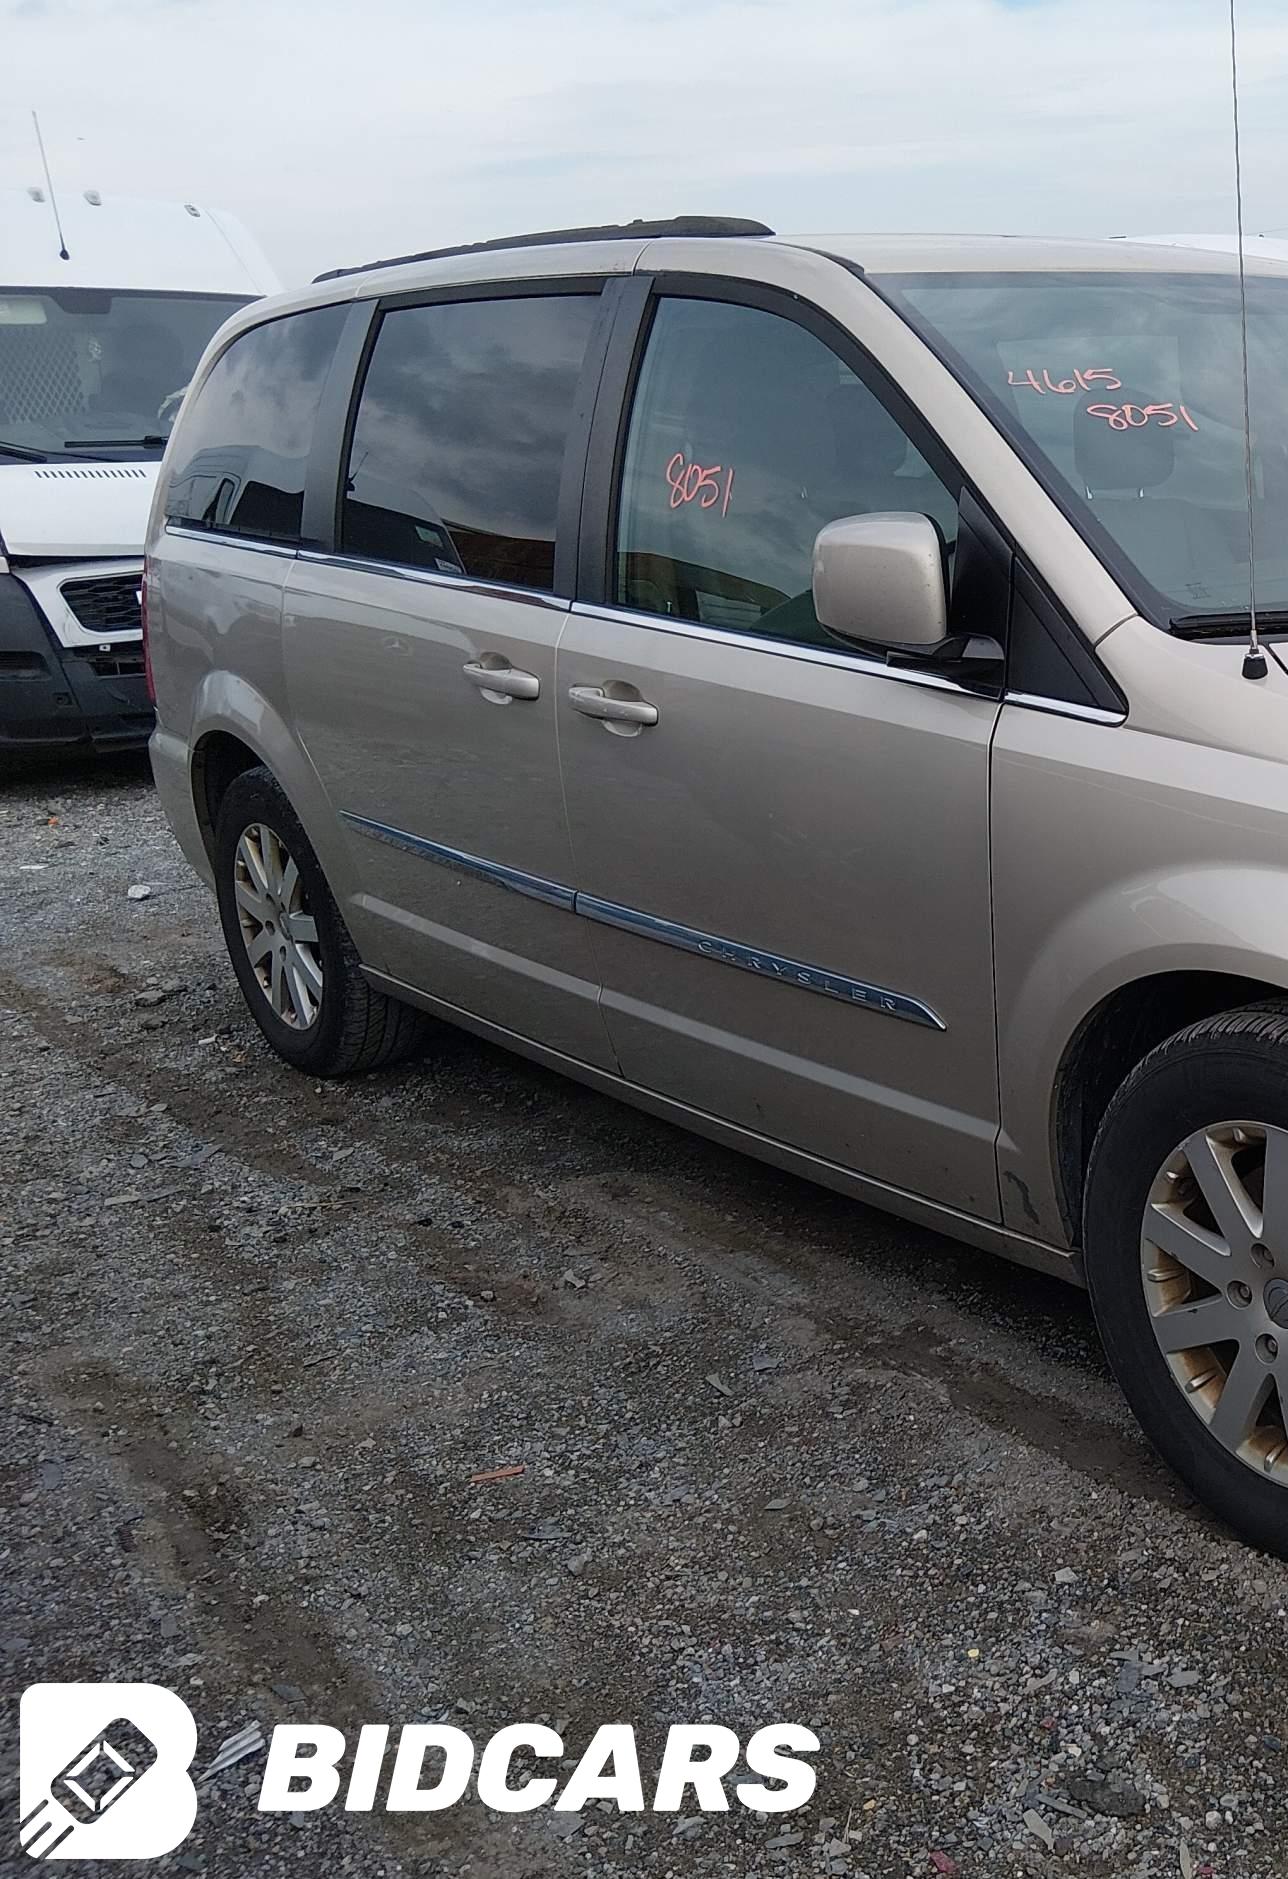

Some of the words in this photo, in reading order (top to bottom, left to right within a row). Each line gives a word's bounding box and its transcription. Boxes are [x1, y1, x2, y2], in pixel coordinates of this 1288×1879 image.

[1008, 368, 1122, 394] 4615
[1086, 403, 1199, 432] 8051
[666, 452, 734, 518] 8051
[697, 941, 897, 1011] CHRYSLER
